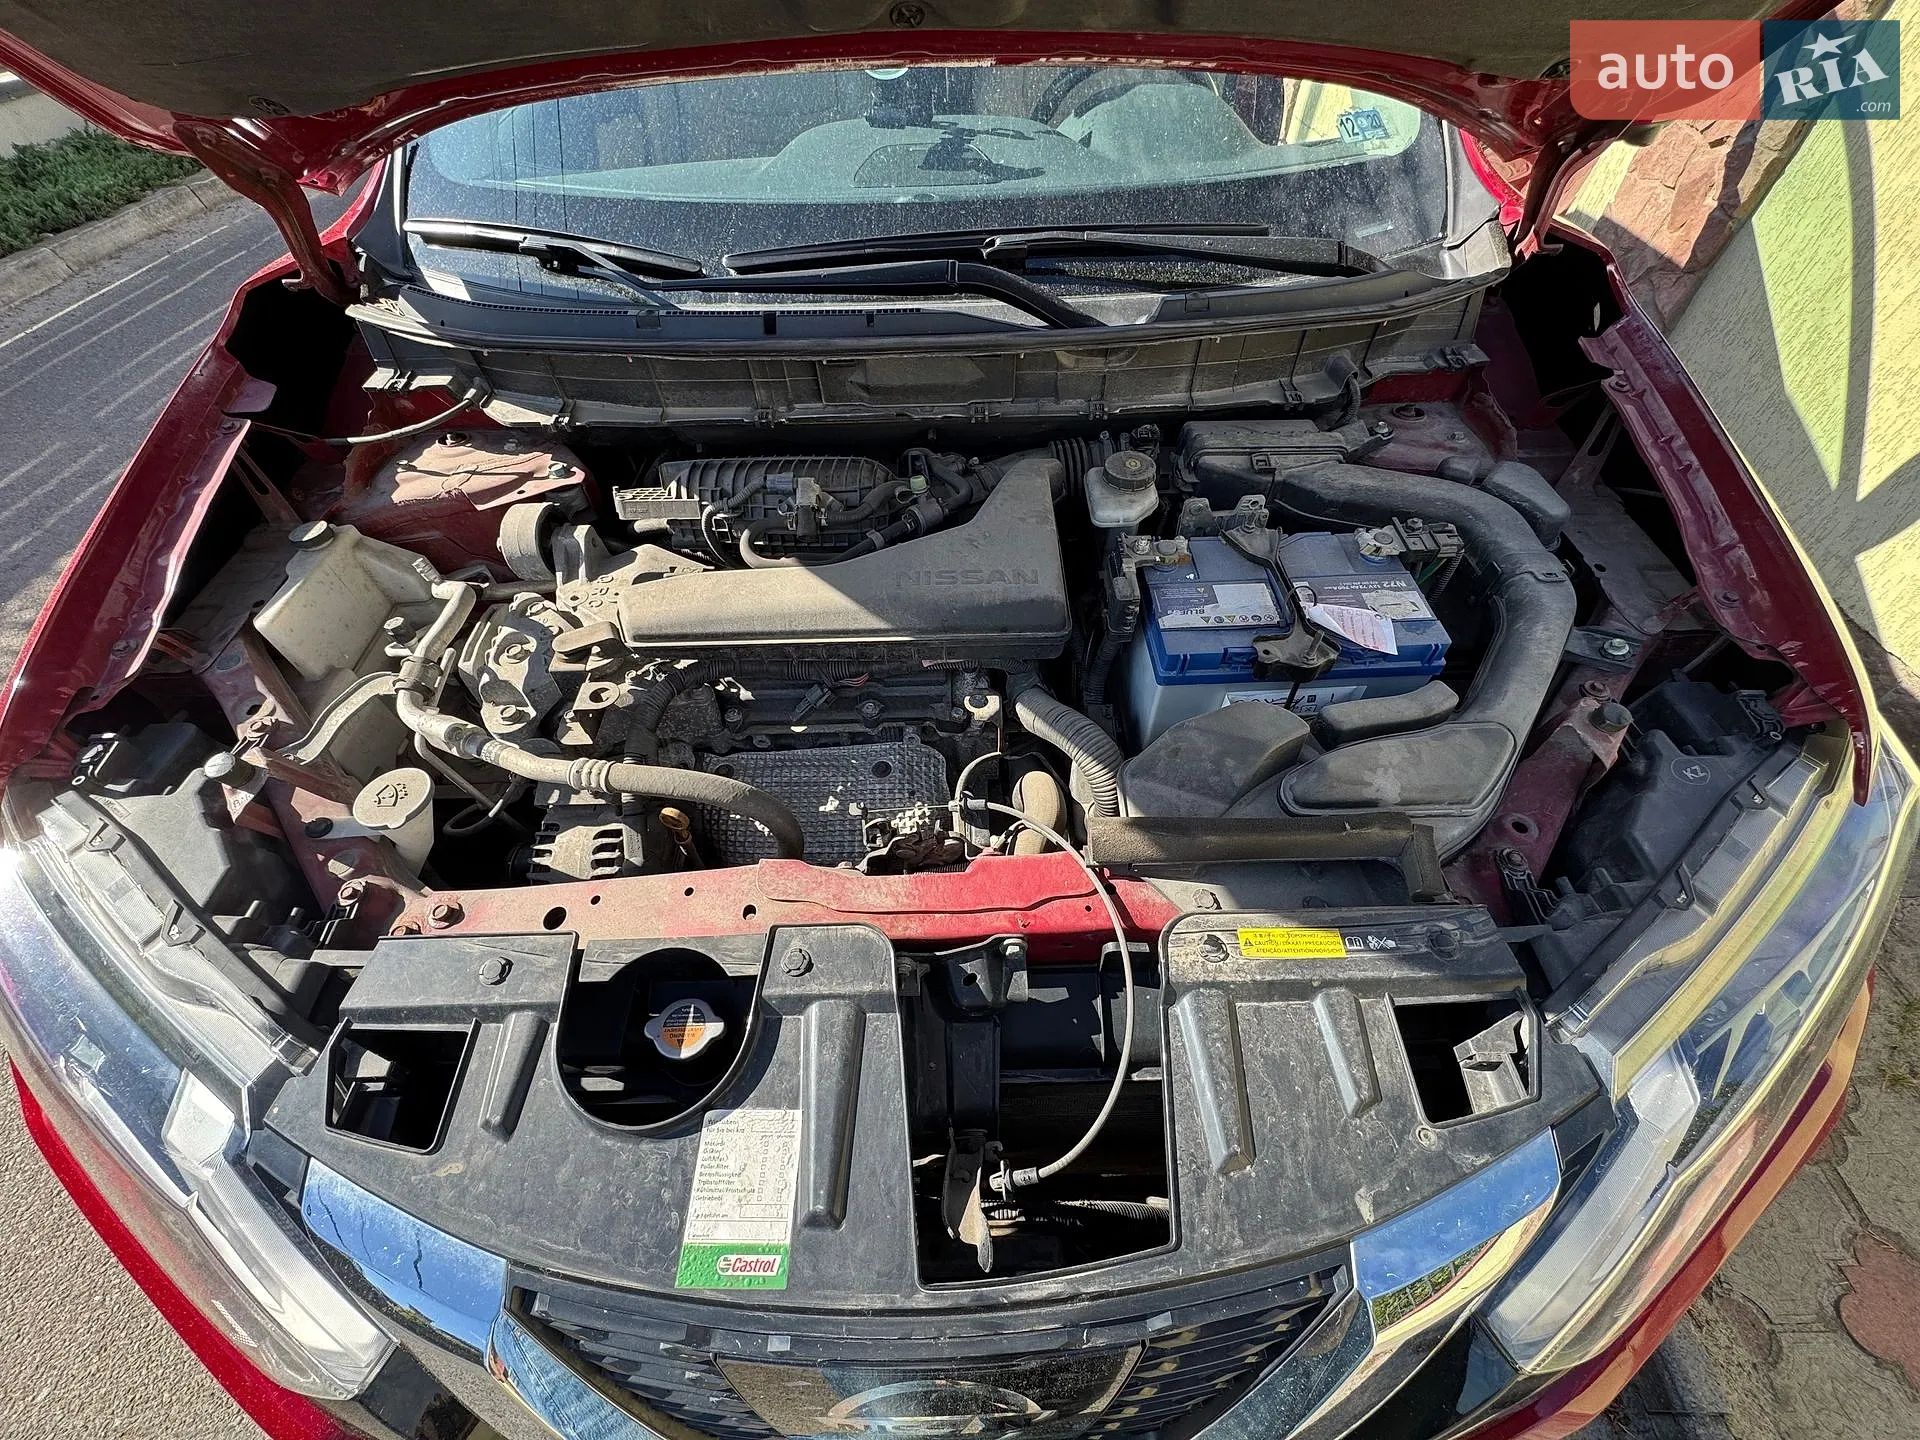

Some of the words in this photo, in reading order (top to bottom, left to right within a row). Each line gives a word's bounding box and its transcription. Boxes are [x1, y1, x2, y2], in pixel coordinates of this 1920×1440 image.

[1340, 117, 1359, 138] 12
[895, 569, 1039, 586] NISSAN
[732, 1257, 777, 1273] Castrol
